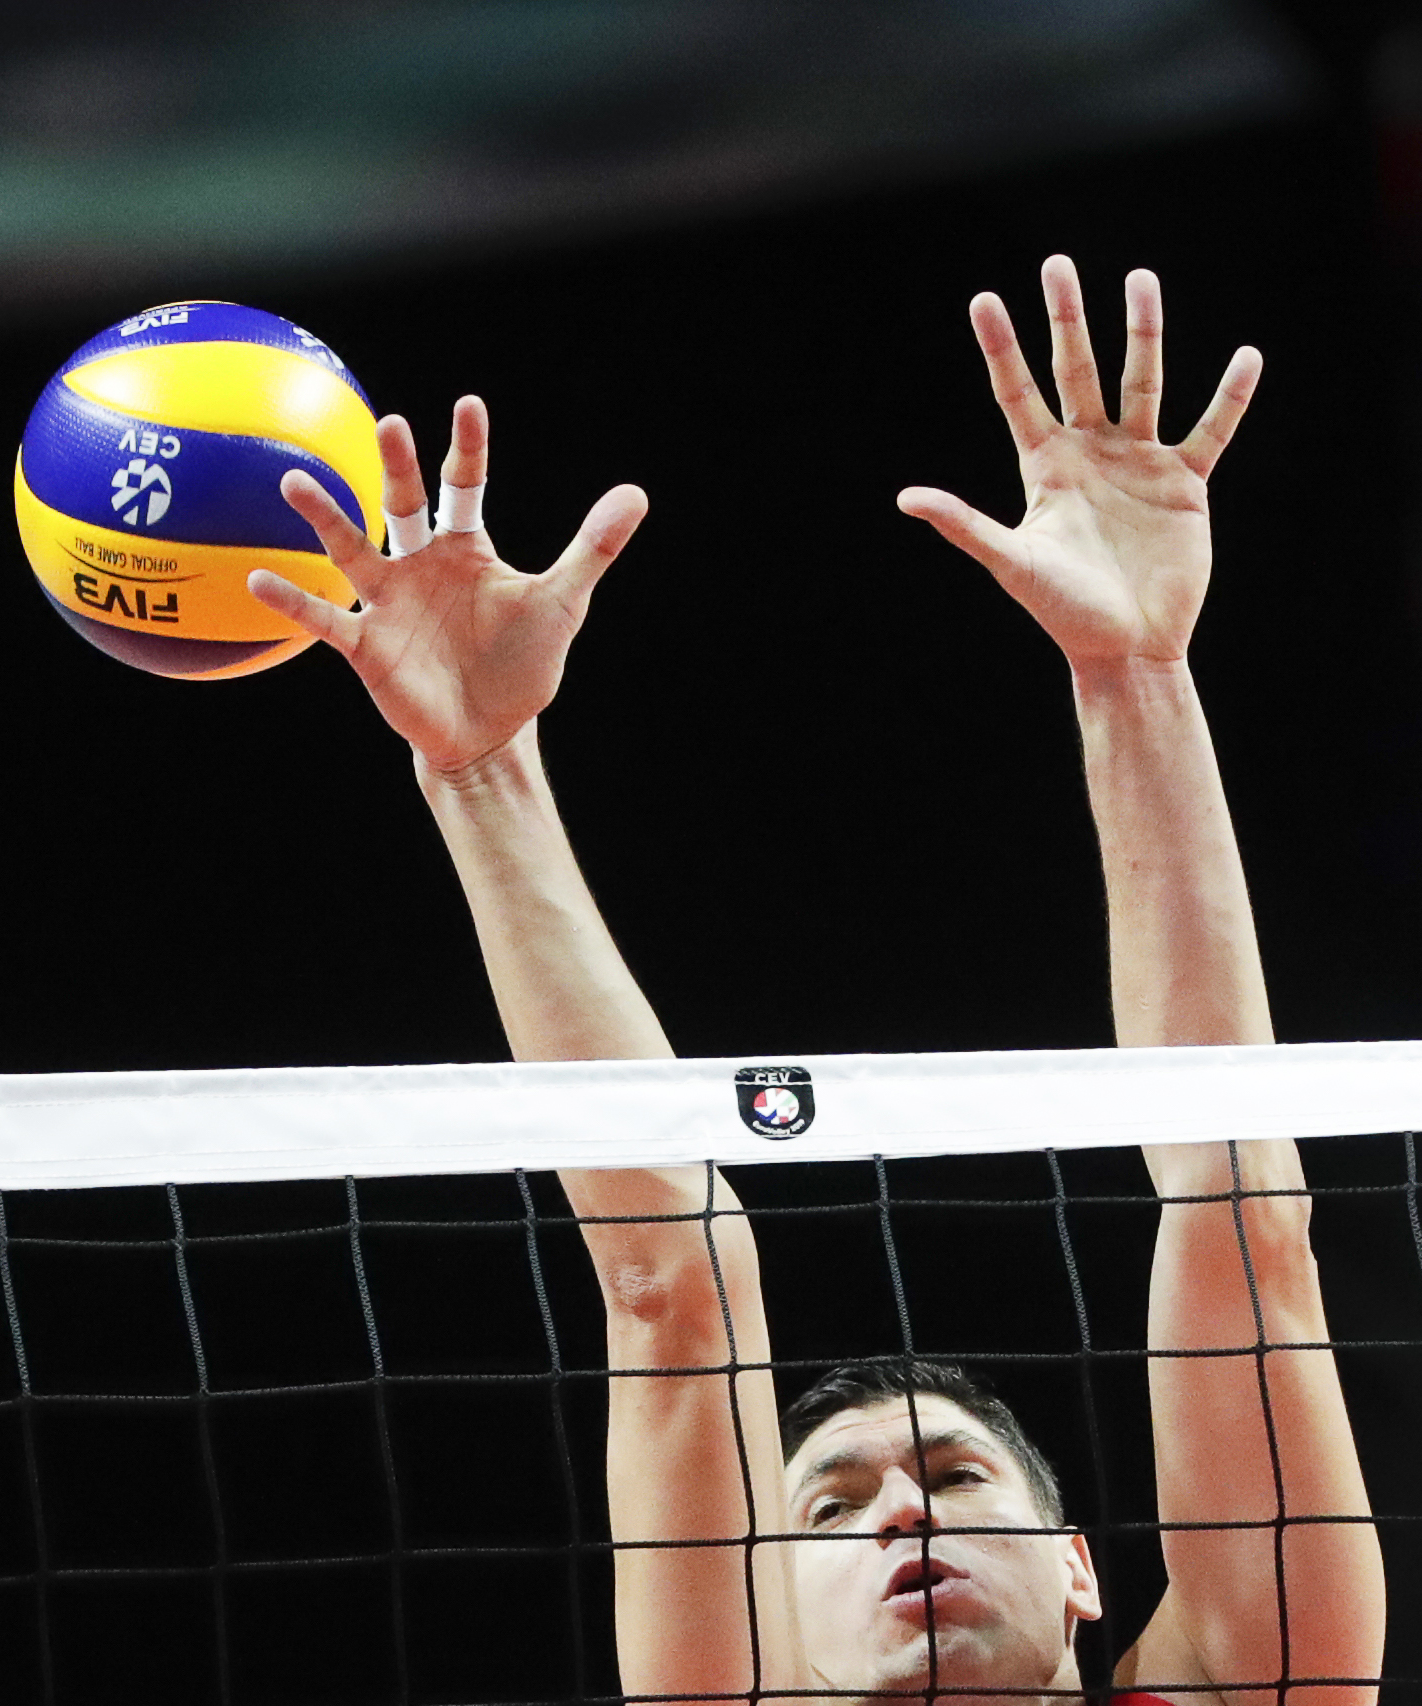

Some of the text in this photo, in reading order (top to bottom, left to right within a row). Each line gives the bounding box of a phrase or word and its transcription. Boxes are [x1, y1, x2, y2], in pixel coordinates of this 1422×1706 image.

[118, 428, 181, 459] CEV
[97, 546, 127, 568] GAME
[132, 554, 178, 573] OFFICIAL
[754, 1071, 791, 1084] CEV
